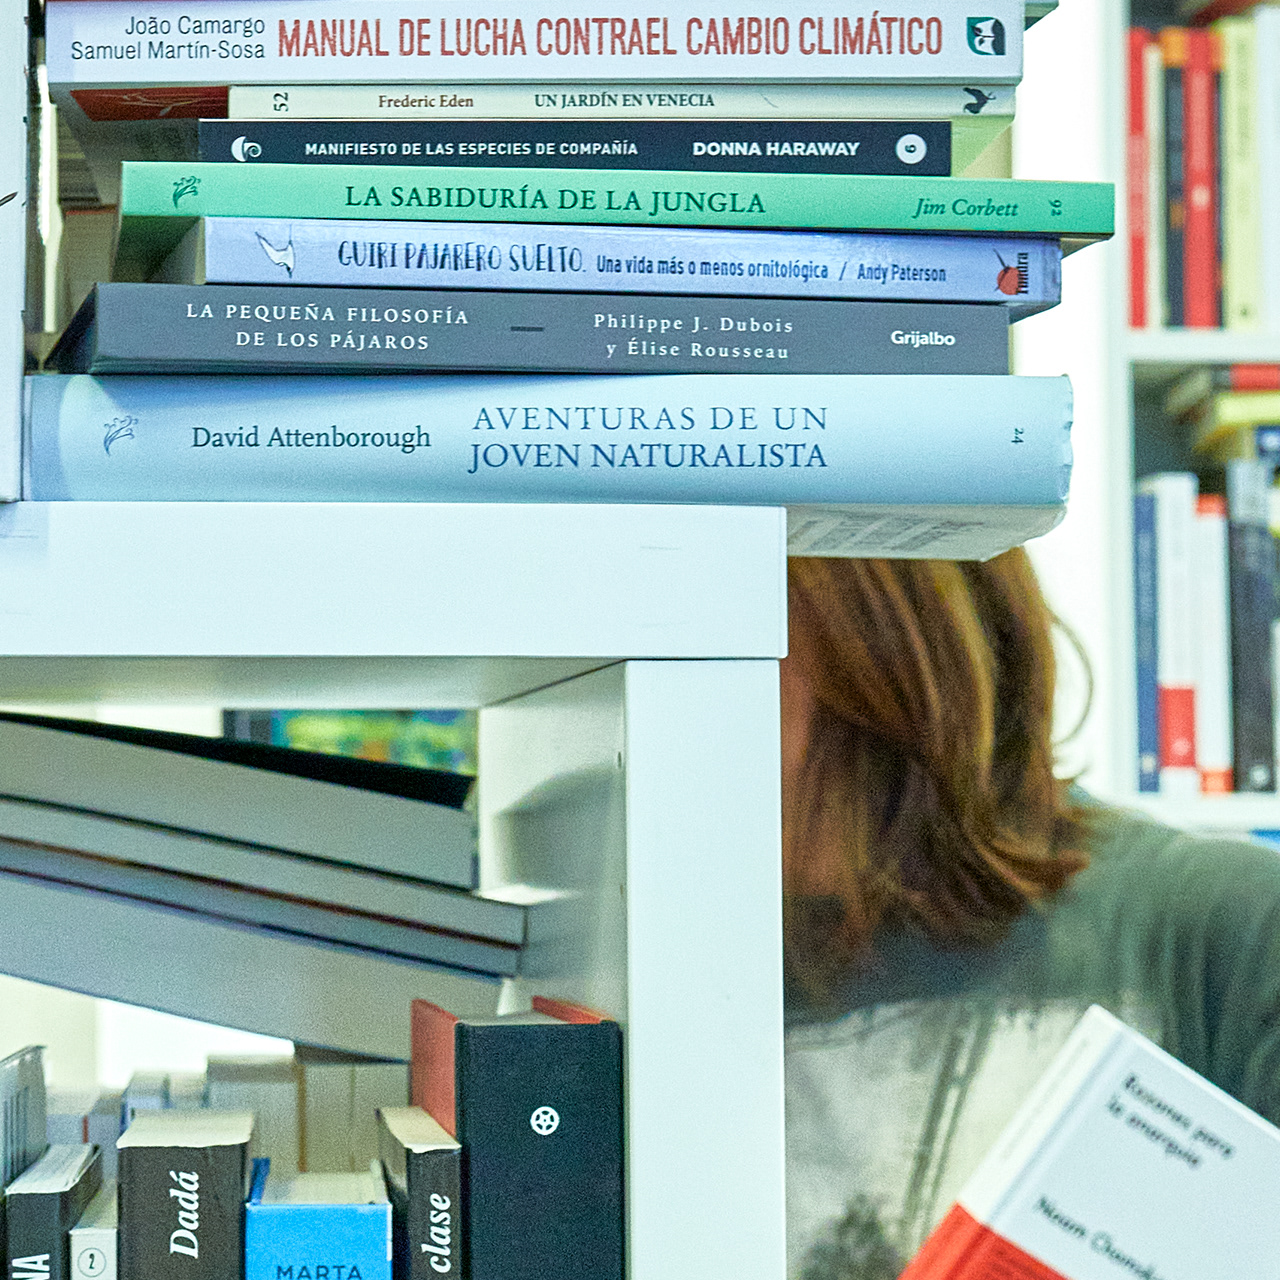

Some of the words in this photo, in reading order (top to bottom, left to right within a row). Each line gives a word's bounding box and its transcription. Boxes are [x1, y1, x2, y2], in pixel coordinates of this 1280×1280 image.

[125, 17, 171, 35] João
[178, 17, 265, 39] Camargo
[278, 18, 389, 58] MANUAL
[400, 18, 430, 56] DE
[440, 19, 527, 57] LUCHA
[686, 17, 789, 55] CAMBIO
[799, 11, 943, 56] CLIMÁTICO
[71, 42, 142, 60] Samuel
[148, 40, 265, 60] Martín-Sosa
[275, 92, 288, 111] 52
[379, 95, 436, 109] Frederic
[440, 95, 474, 109] Eden
[535, 94, 557, 108] UN
[561, 93, 618, 108] JARDÍN
[622, 94, 643, 107] EN
[646, 94, 715, 107] VENECIA
[306, 144, 396, 156] MANIFIESTO
[402, 144, 421, 155] DE
[427, 144, 454, 155] LAS
[459, 144, 531, 155] ESPECIES
[535, 144, 555, 155] DE
[559, 139, 638, 156] COMPAÑÍA
[693, 142, 761, 155] DONNA
[766, 142, 860, 155] HARAWAY
[346, 186, 381, 206] LA
[391, 184, 549, 209] SABIDURÍA
[559, 189, 596, 210] DE
[607, 189, 642, 211] LA
[649, 191, 766, 216] JUNGLA
[913, 198, 945, 218] Jim
[951, 198, 1019, 217] Corbett
[187, 304, 213, 318] LA
[226, 302, 334, 320] PEQUEÑA
[347, 304, 468, 324] FILOSOFÍA
[237, 331, 265, 346] DE
[277, 332, 318, 348] LOS
[331, 329, 429, 351] PÁJAROS
[891, 330, 955, 347] Grijalbo
[474, 407, 695, 431] AVENTURAS
[710, 407, 758, 430] DE
[774, 407, 827, 430] UN
[192, 426, 259, 448] David
[267, 426, 431, 453] Attenborough
[468, 444, 579, 474] JOVEN
[592, 444, 827, 468] NATURALISTA
[170, 1170, 199, 1259] Dadá
[420, 1192, 452, 1274] clase
[276, 1265, 363, 1280] MARTA
